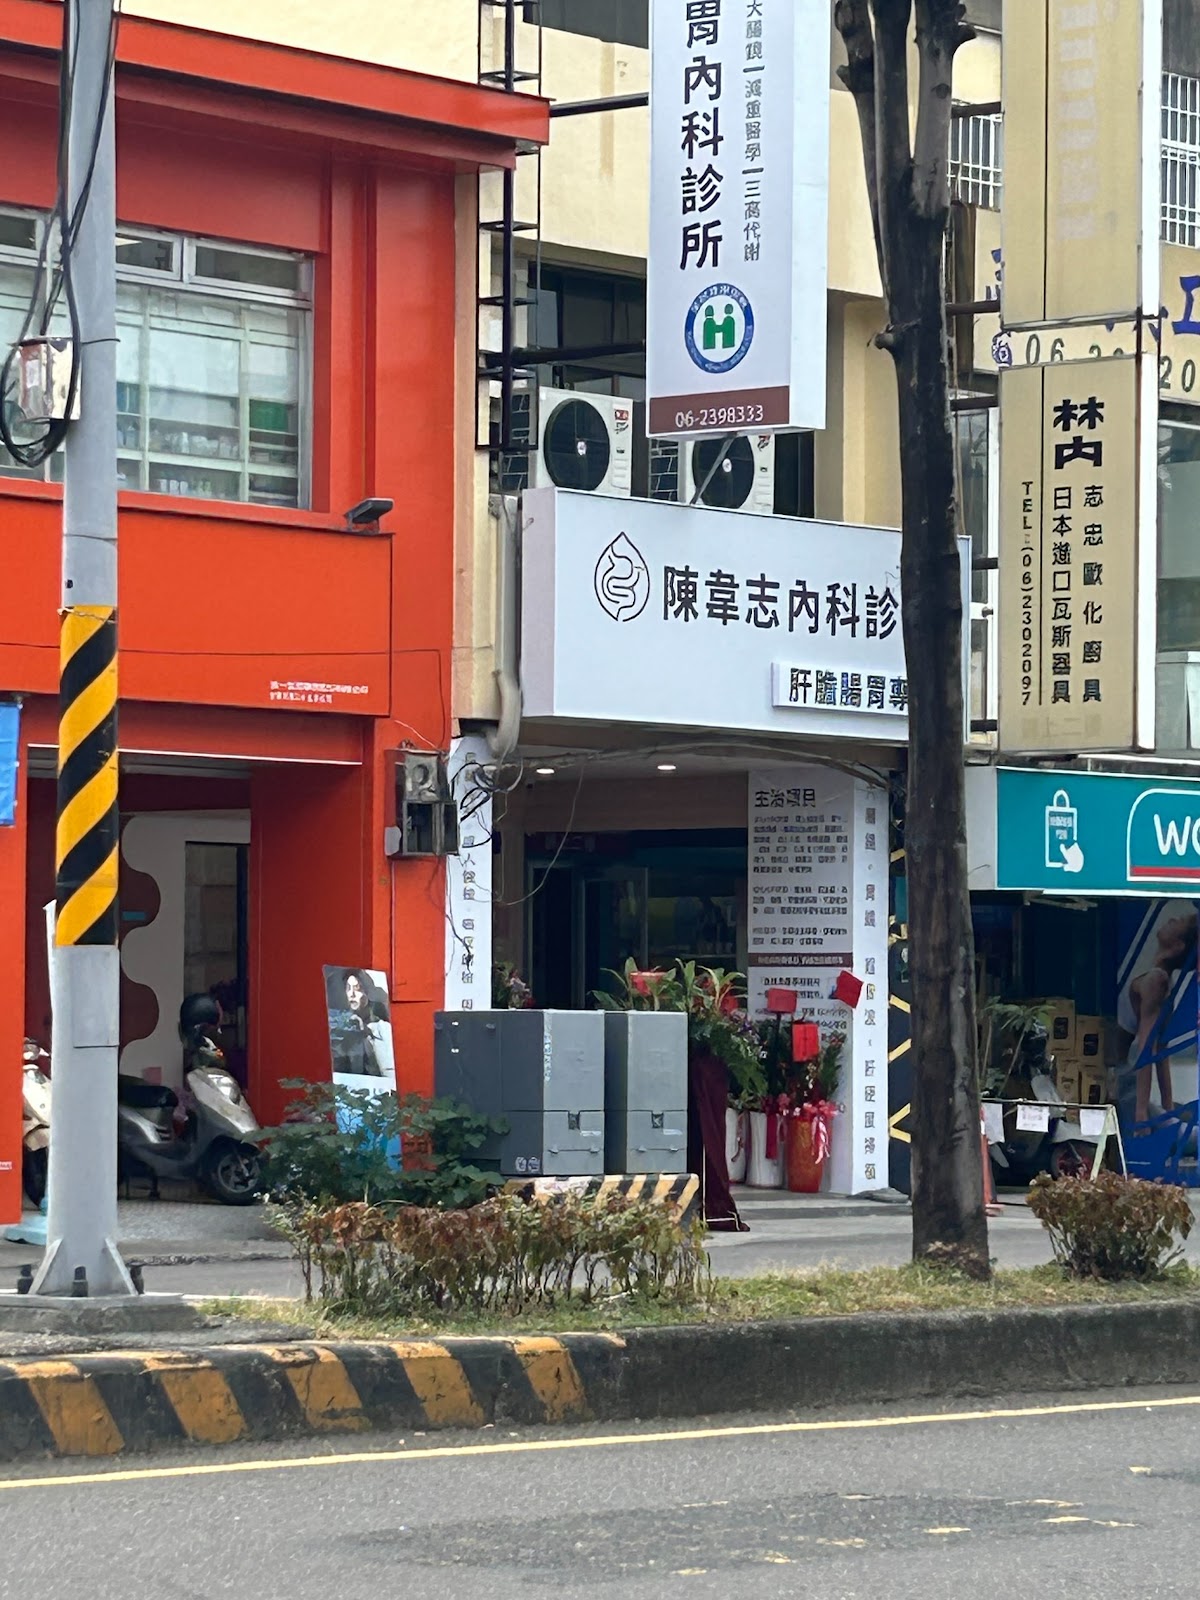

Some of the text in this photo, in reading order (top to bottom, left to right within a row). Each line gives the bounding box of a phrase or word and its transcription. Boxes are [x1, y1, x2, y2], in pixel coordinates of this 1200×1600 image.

[675, 404, 764, 428] 06-2398333
[1052, 486, 1072, 704] 日本進口瓦斯器具
